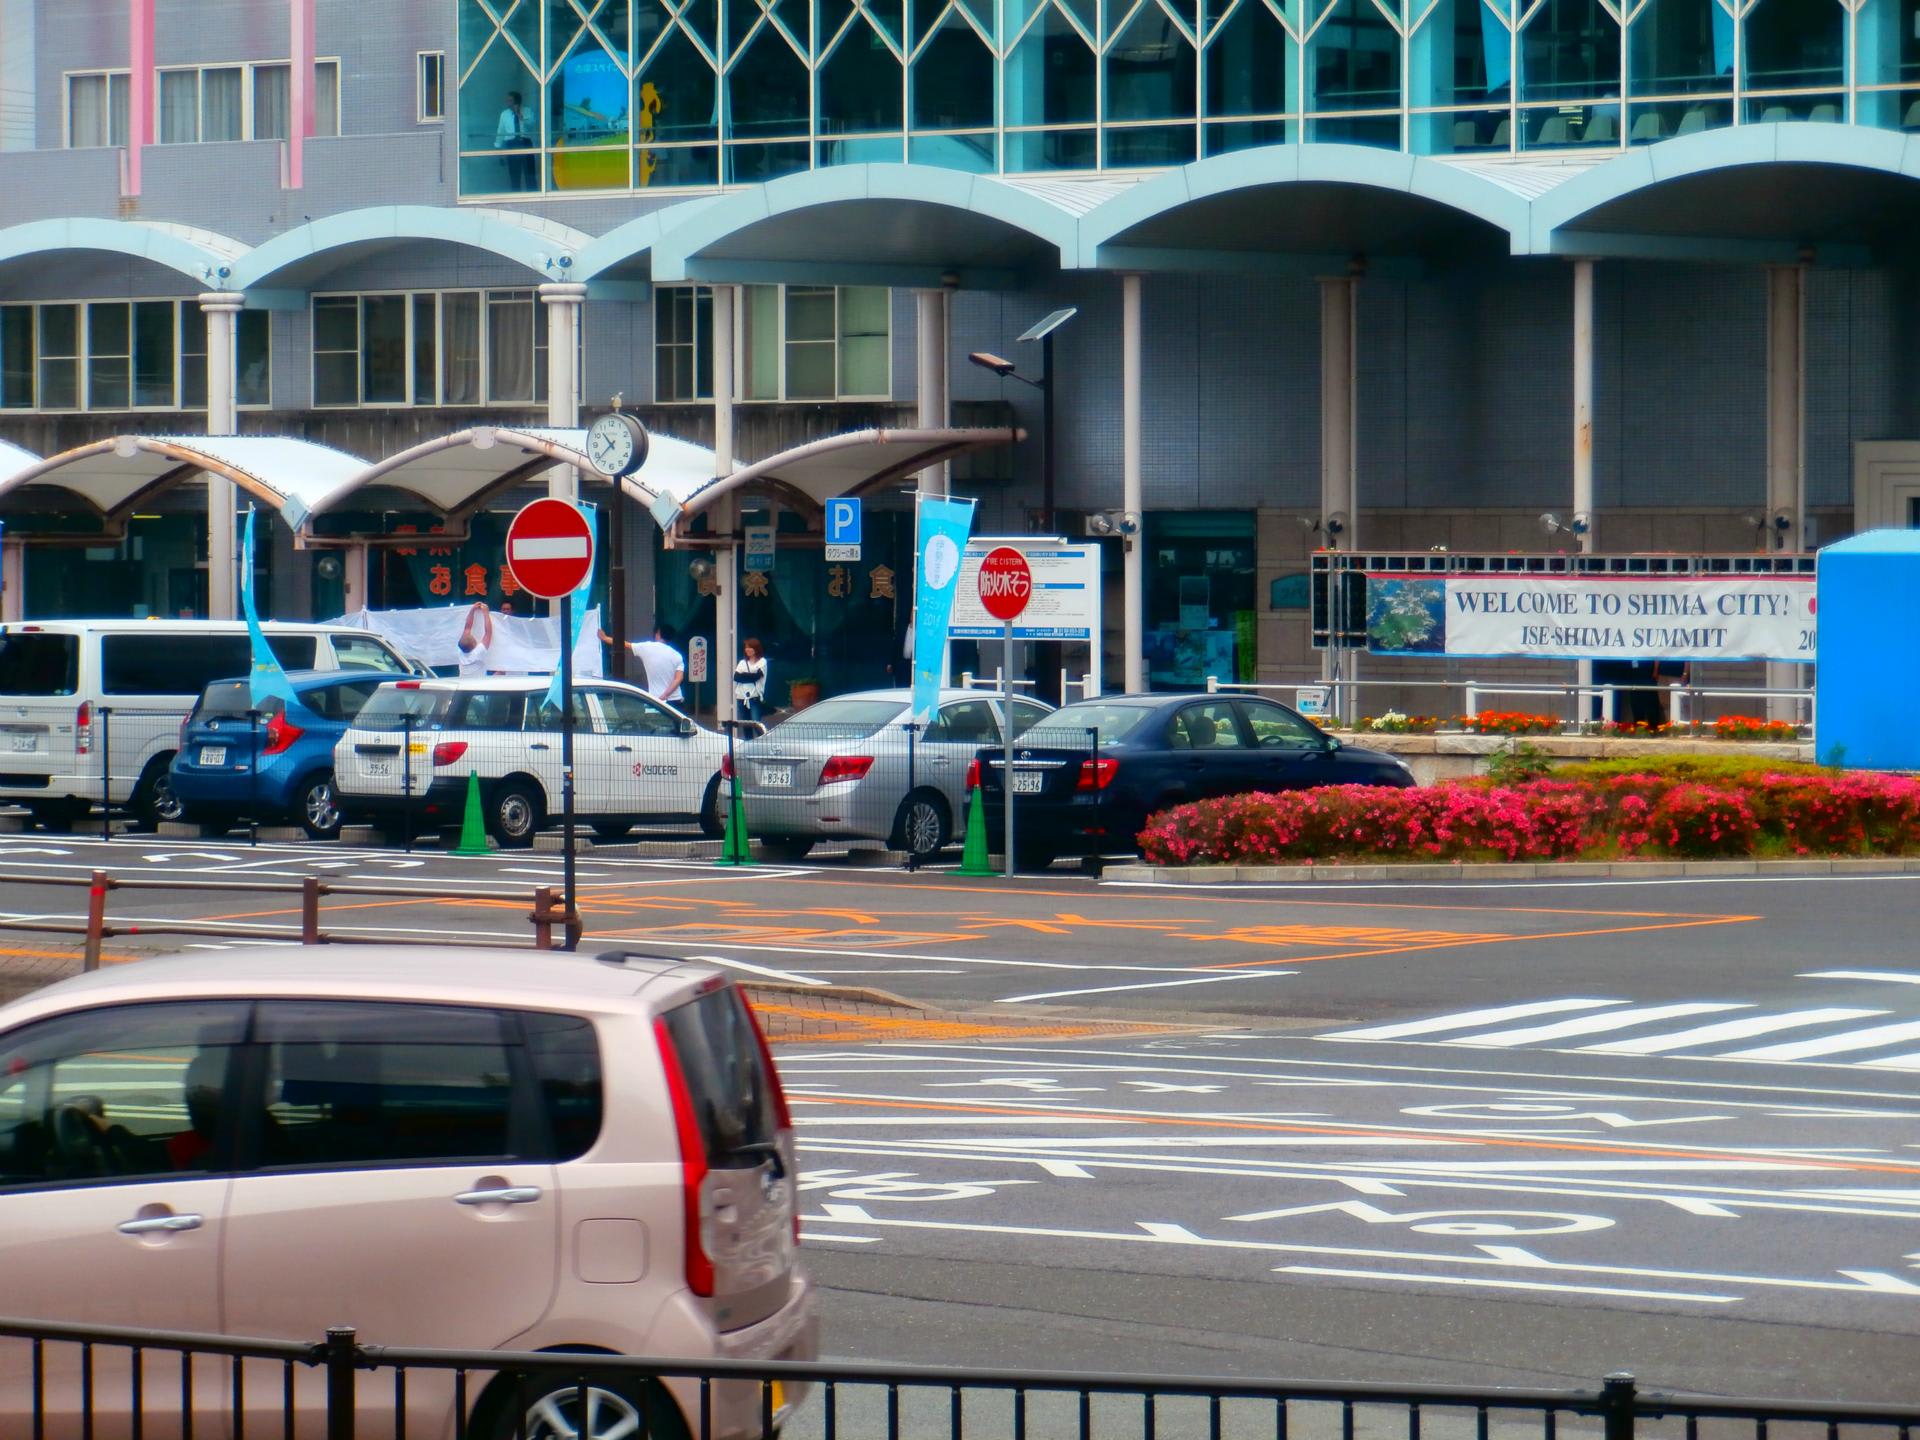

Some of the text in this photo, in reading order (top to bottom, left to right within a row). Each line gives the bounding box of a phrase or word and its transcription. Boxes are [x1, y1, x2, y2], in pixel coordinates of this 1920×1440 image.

[834, 503, 854, 539] P
[986, 557, 1023, 566] FIRE CISTERN
[1455, 591, 1790, 616] WELCOME TO SHIMA CITY!
[1521, 625, 1626, 648] ISE-SHIMA
[1632, 627, 1728, 648] SUMMIT
